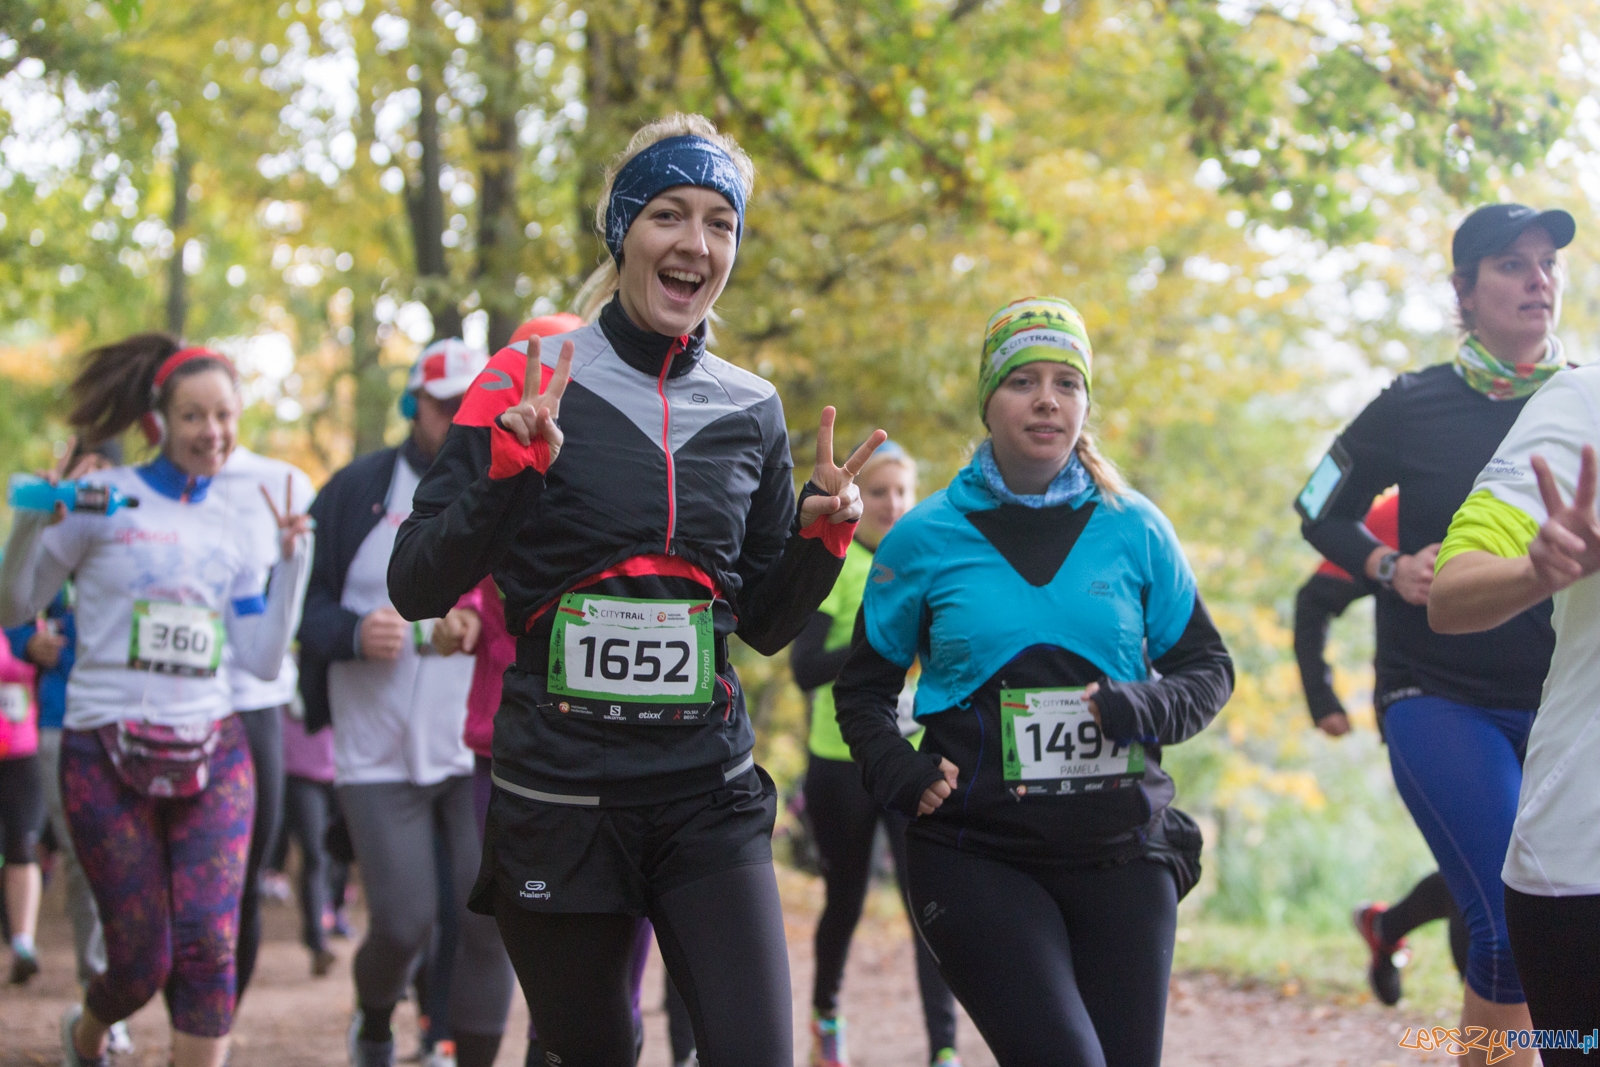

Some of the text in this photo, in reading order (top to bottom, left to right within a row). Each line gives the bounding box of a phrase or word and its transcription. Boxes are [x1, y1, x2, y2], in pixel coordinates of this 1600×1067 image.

[152, 622, 208, 653] 360
[579, 636, 691, 683] 1652
[701, 649, 710, 690] Poznań
[1060, 764, 1100, 775] PAMELA
[520, 890, 551, 900] Kalenji
